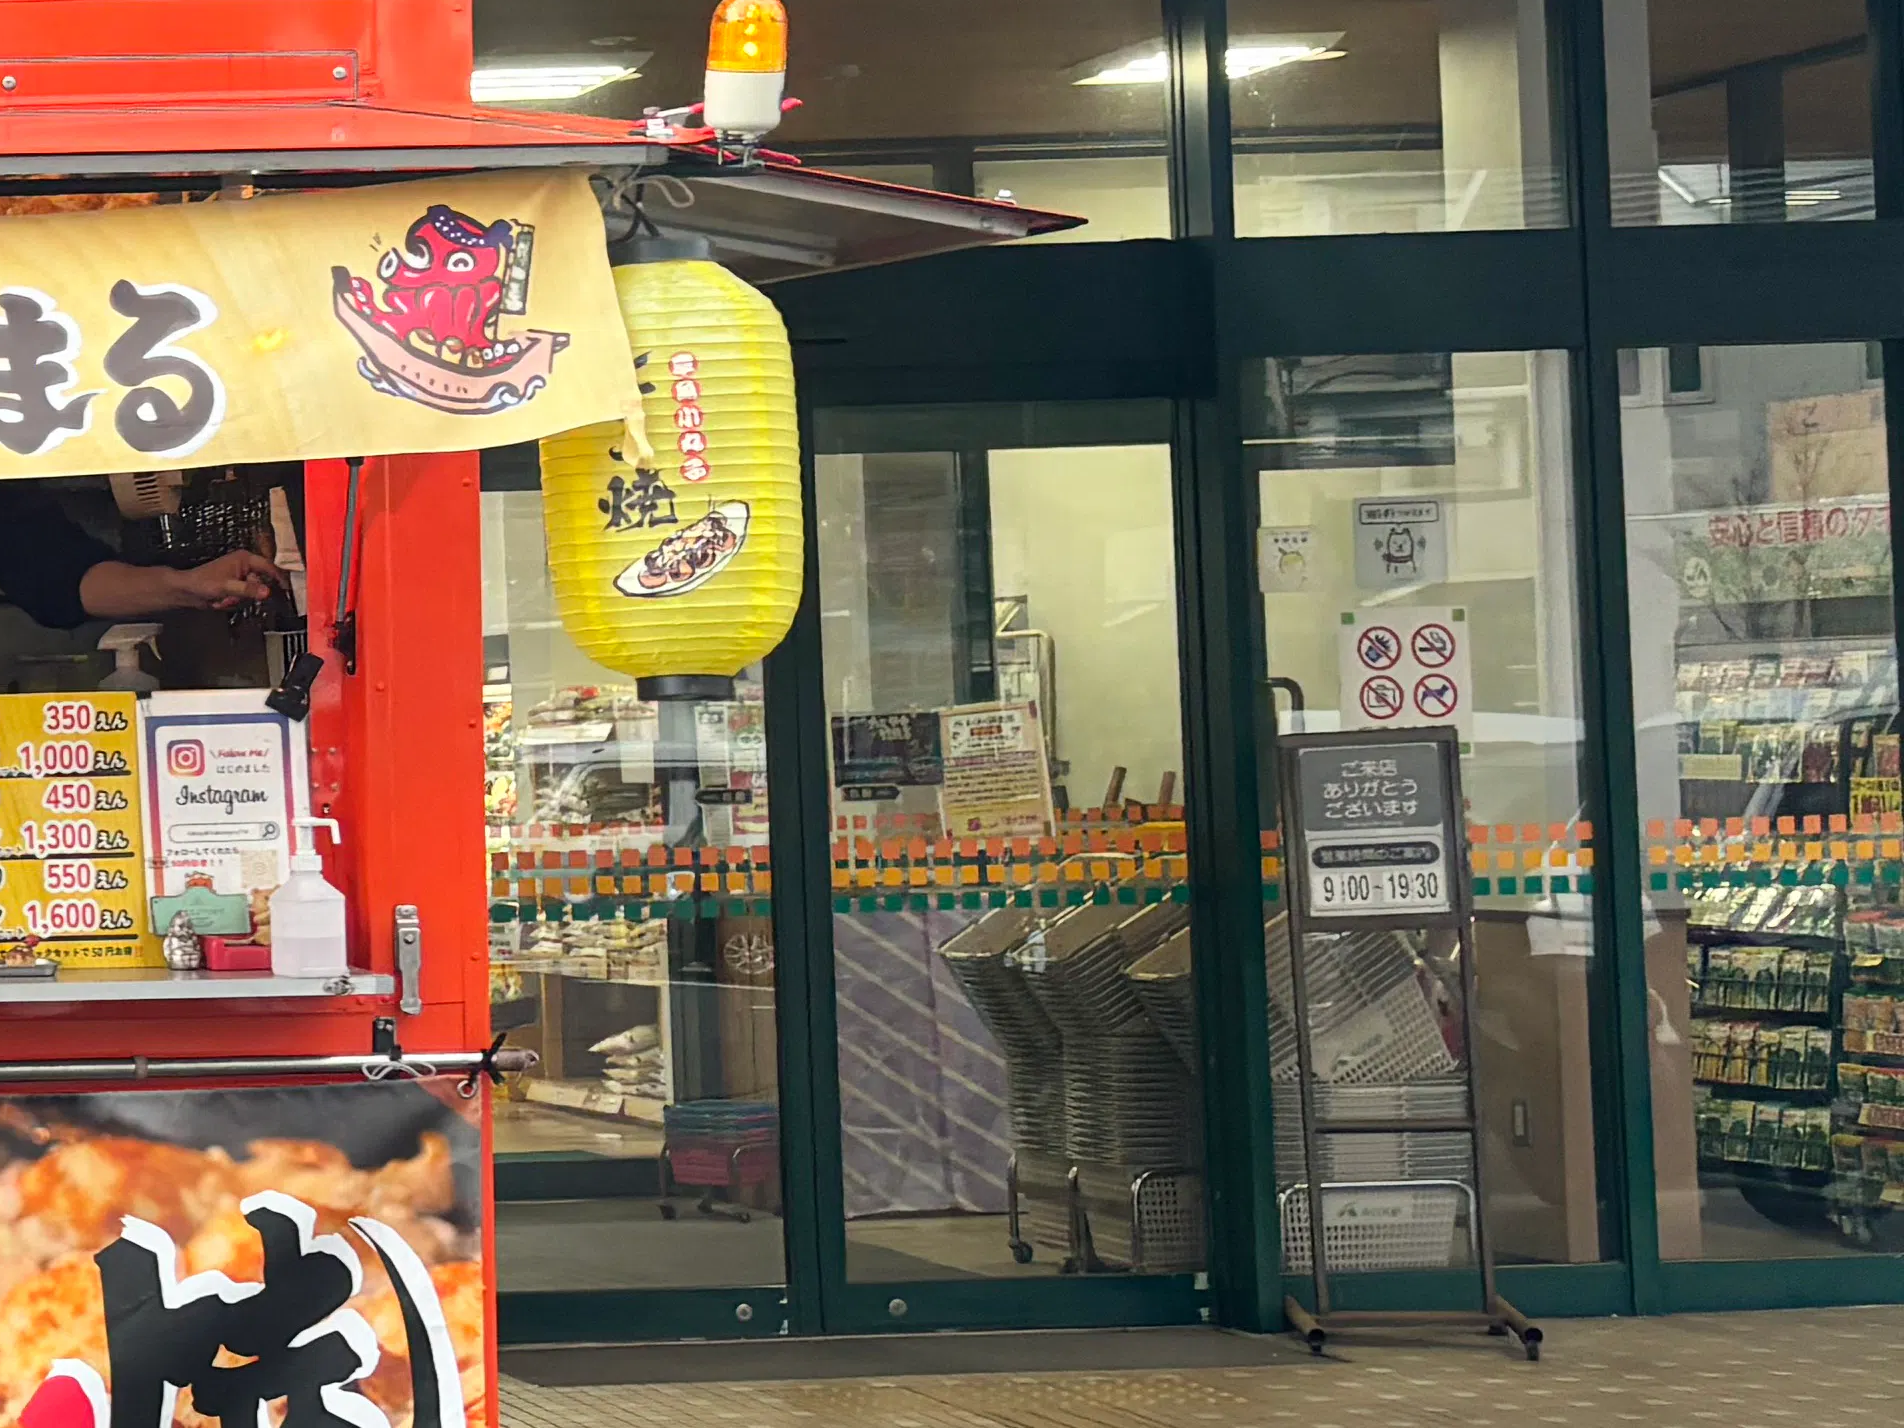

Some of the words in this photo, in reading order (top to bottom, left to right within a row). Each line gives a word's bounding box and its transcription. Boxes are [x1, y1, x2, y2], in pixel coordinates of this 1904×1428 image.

[1341, 759, 1398, 778] ご来店
[175, 784, 269, 815] Instagram
[1323, 778, 1418, 800] ありがとう
[1324, 799, 1419, 819] ございます
